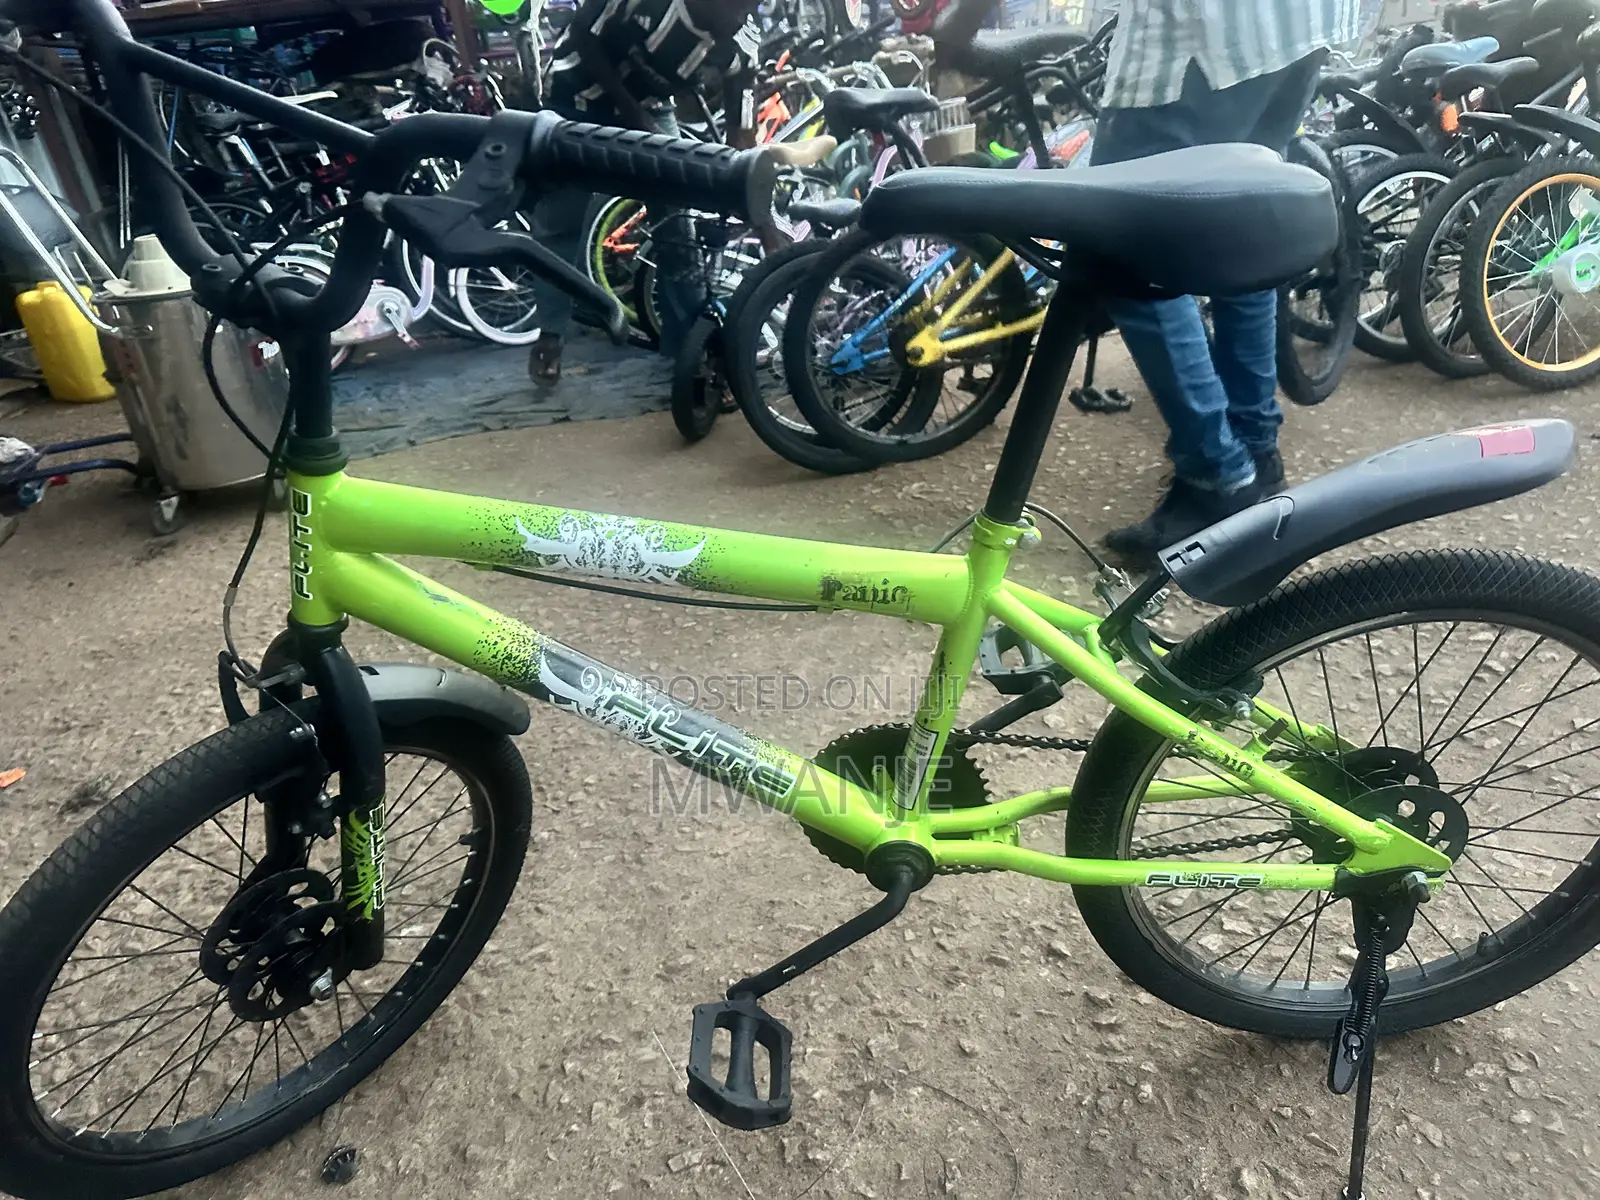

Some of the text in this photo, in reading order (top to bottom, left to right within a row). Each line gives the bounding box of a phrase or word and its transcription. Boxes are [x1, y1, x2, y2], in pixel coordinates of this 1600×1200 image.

[291, 487, 313, 601] FLITE
[819, 575, 909, 611] Panic
[599, 690, 797, 799] FLITE
[1146, 871, 1263, 889] FLITE
